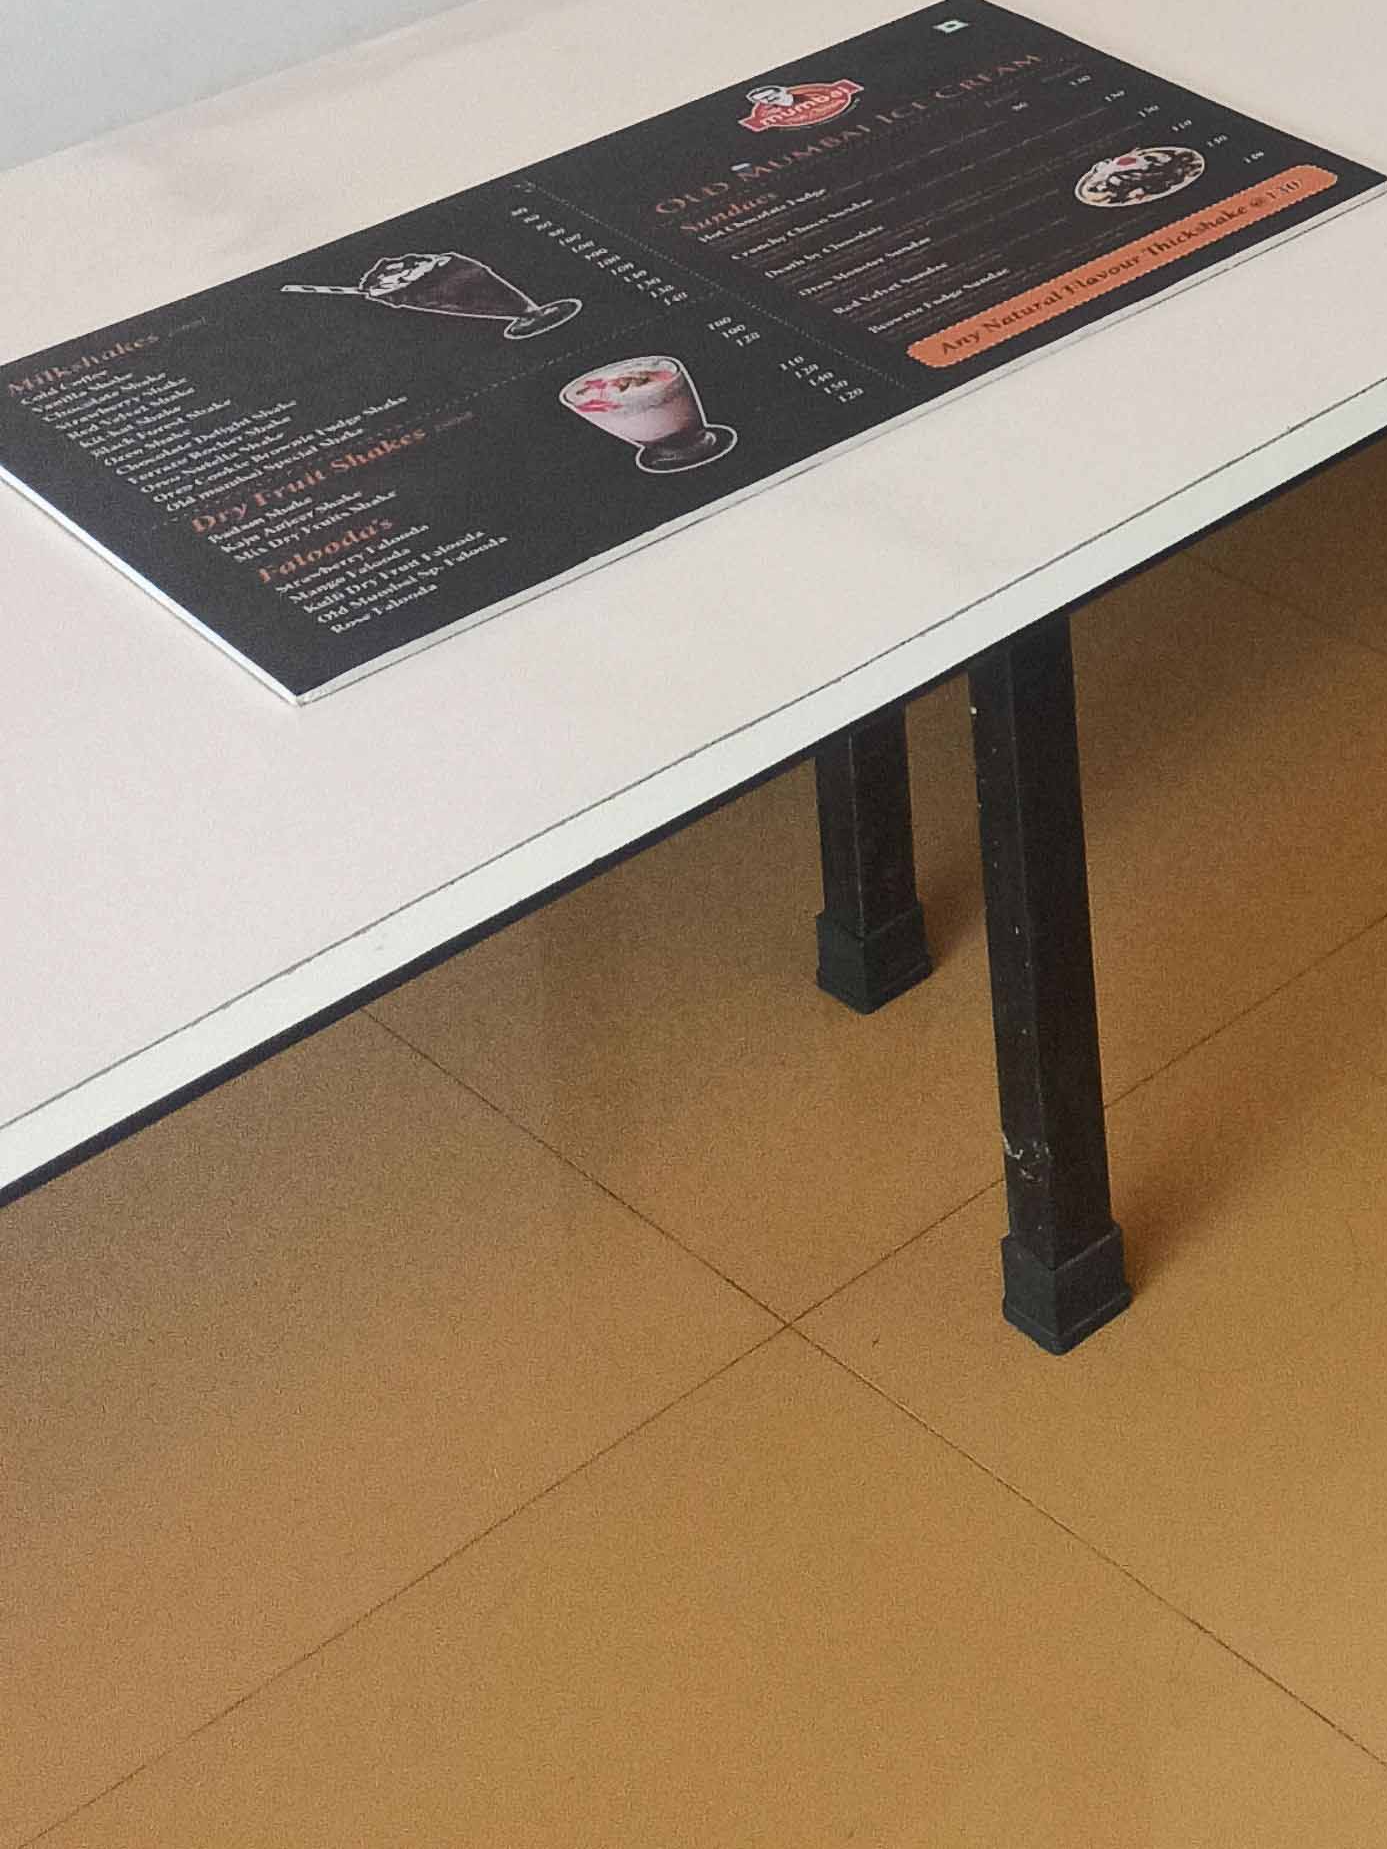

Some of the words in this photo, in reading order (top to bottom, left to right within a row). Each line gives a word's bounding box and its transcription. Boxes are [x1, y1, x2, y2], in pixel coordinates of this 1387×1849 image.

[942, 331, 979, 355] Any
[981, 291, 1063, 332] Natural
[1062, 256, 1139, 295] Flavour
[1142, 207, 1247, 256] Thickshake
[192, 504, 246, 532] Dry
[331, 432, 425, 469] Shakes
